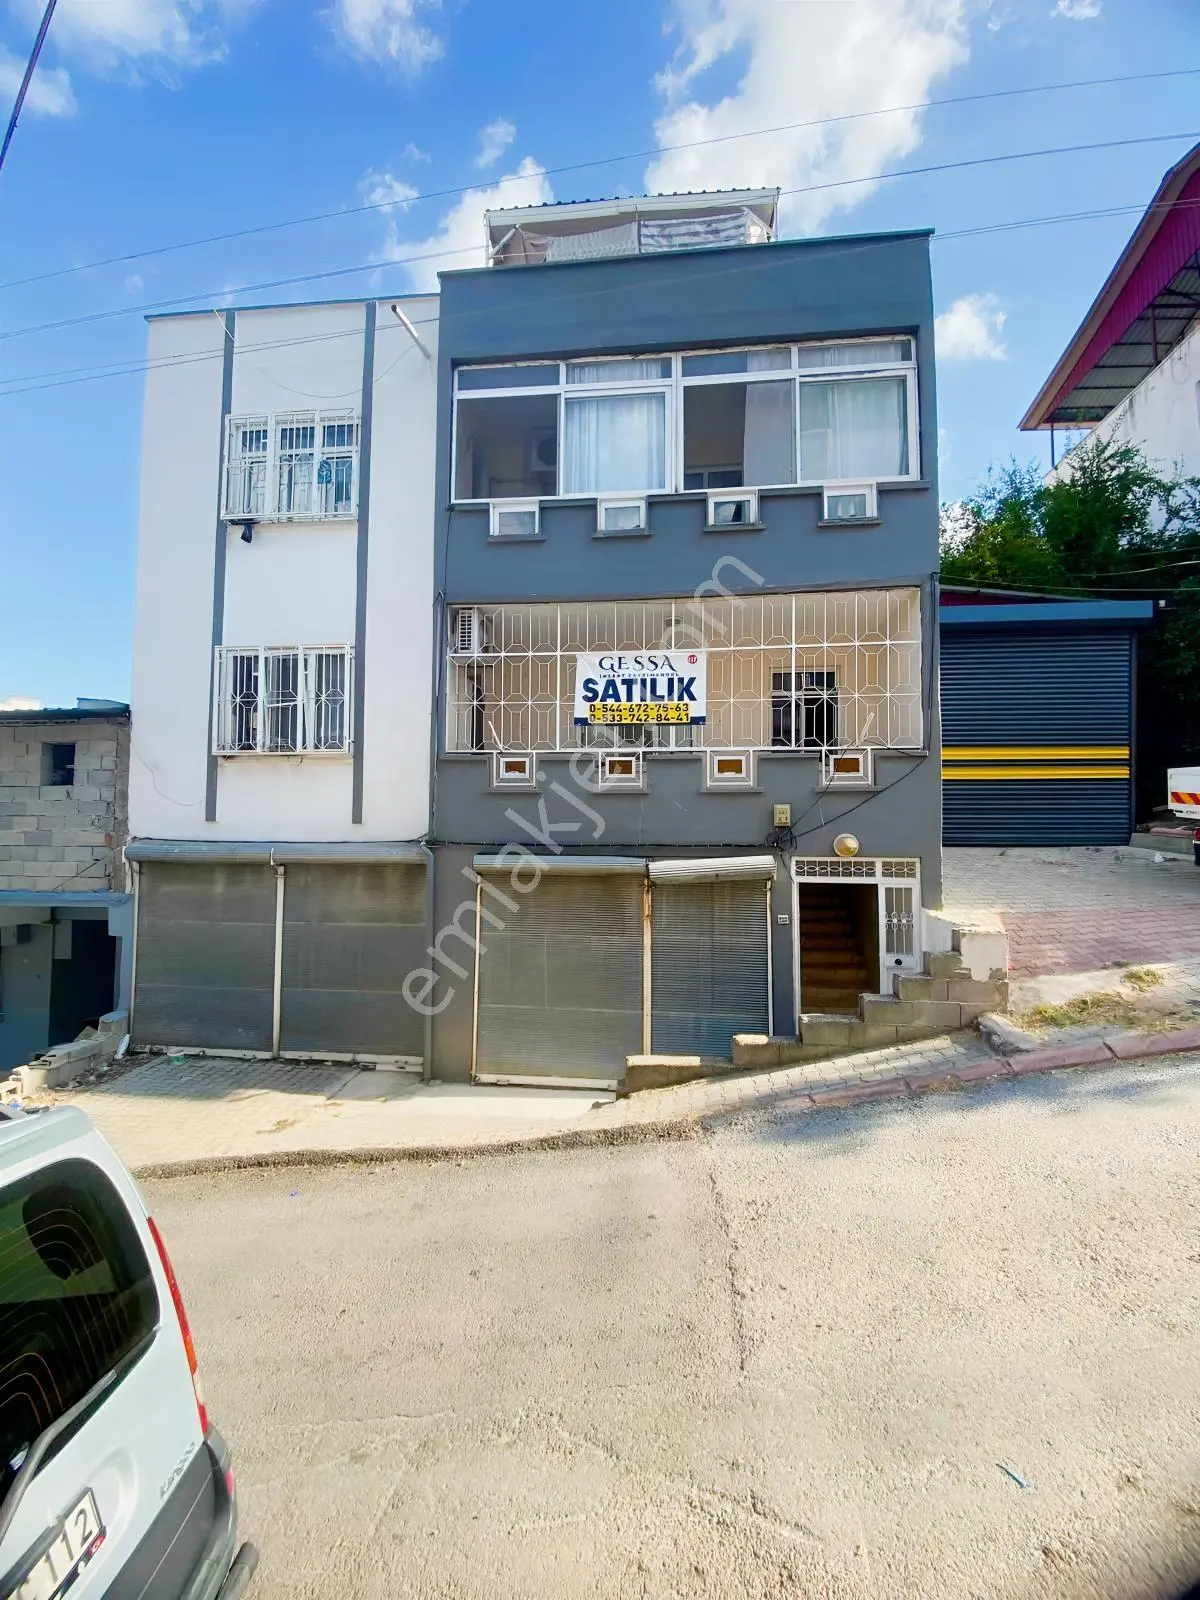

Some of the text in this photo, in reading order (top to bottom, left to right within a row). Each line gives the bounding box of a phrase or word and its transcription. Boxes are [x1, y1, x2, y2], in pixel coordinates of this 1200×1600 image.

[598, 655, 678, 673] GESSA
[582, 677, 698, 702] SATILIK
[589, 703, 689, 713] 0-544-672-75-63
[589, 713, 689, 723] 0-533-742-84-41
[43, 1508, 93, 1585] 112
